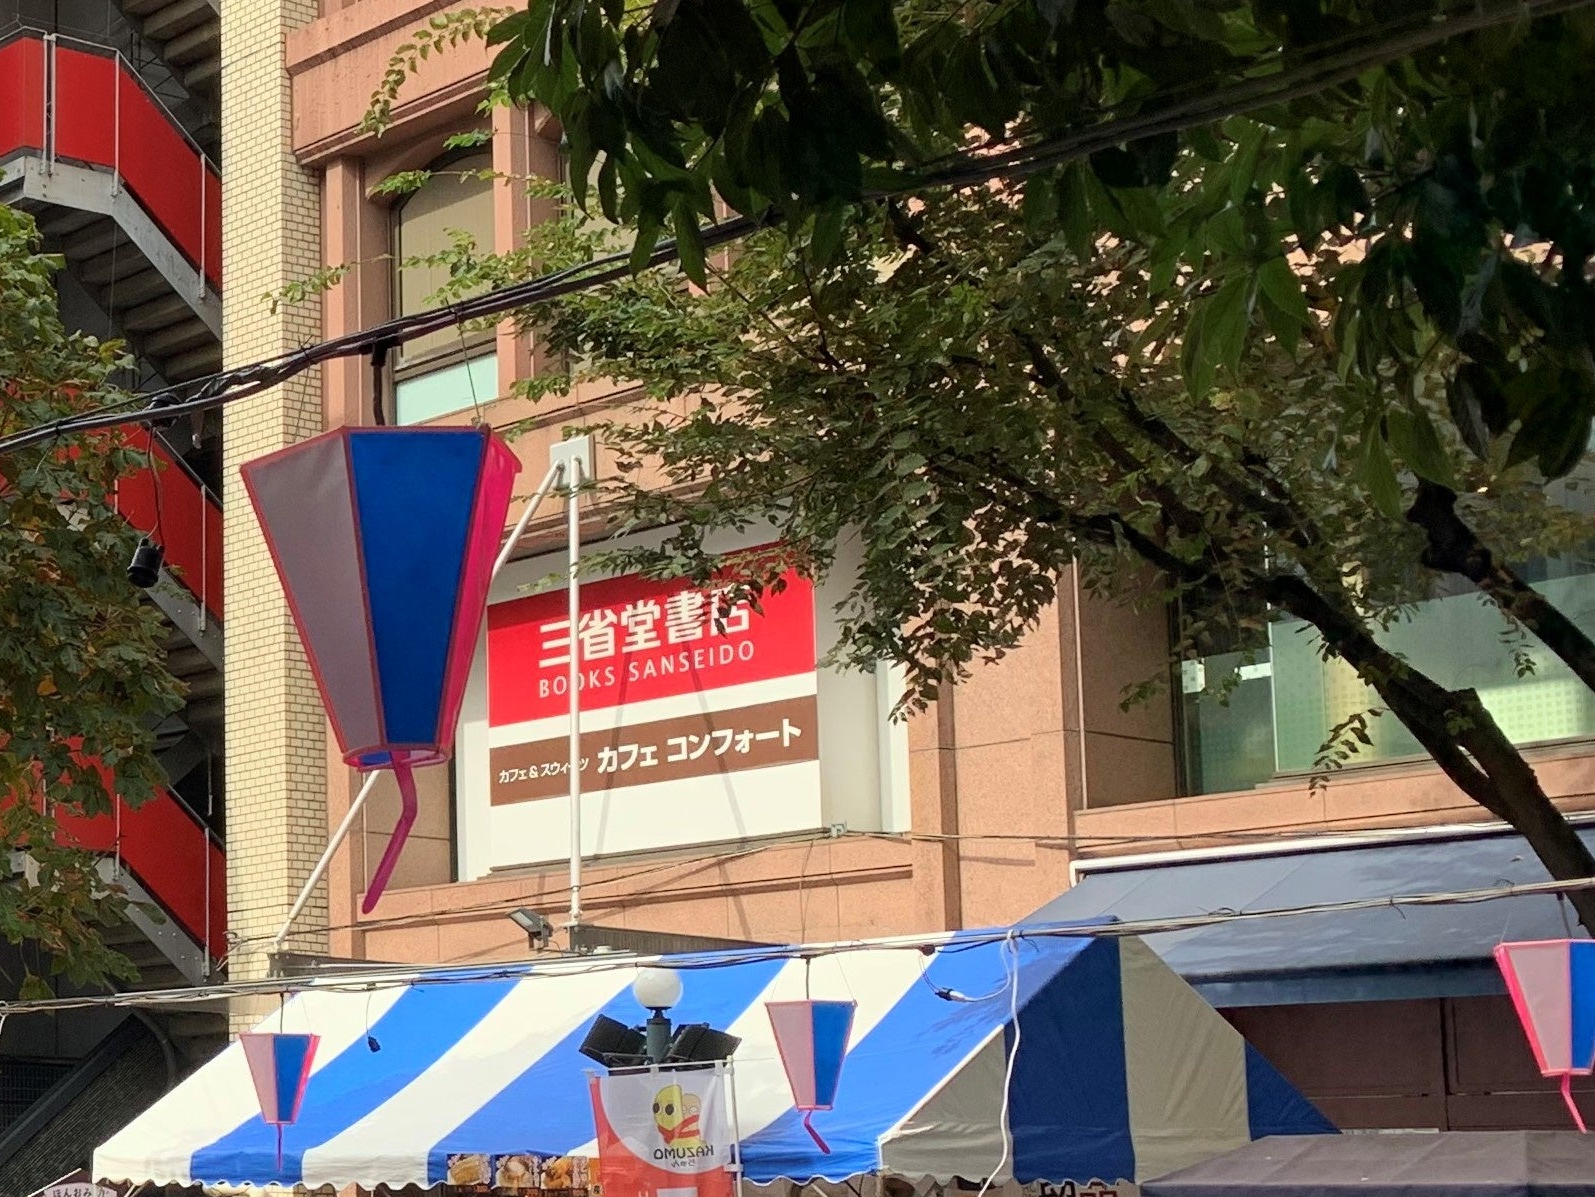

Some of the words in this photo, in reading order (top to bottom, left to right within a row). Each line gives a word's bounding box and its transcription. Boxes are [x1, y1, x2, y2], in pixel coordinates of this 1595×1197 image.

[539, 583, 751, 669] 三省堂書店
[539, 666, 616, 698] BOOKS
[628, 640, 755, 682] SANSEIDO
[598, 743, 659, 774] カフェ
[666, 717, 802, 763] コンフォート
